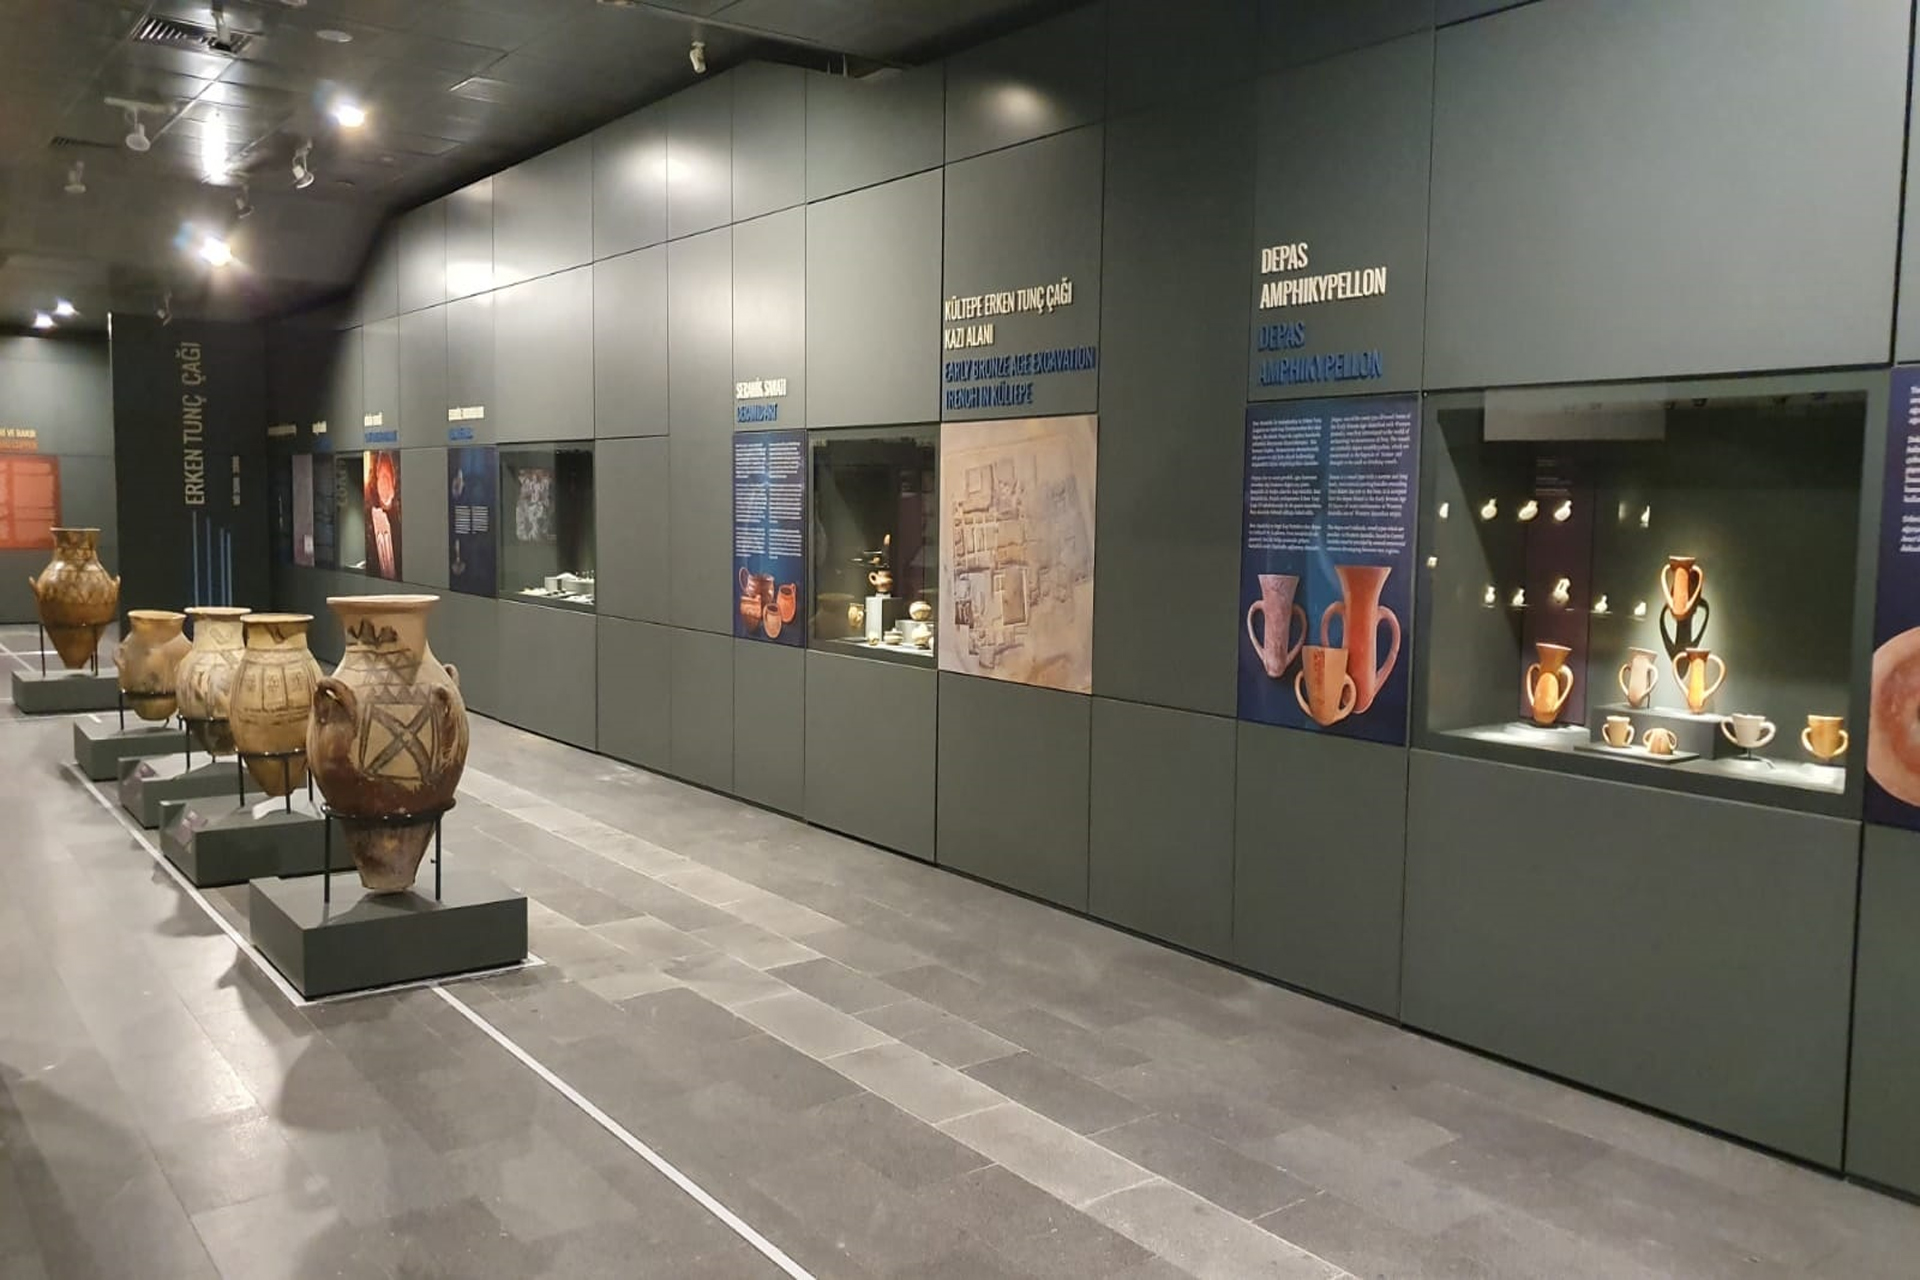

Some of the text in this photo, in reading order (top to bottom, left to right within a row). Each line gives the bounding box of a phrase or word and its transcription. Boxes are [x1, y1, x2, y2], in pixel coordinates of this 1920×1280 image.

[1261, 242, 1309, 274] DEPAS
[944, 276, 1073, 323] KÜLTEPE ERKEN TUNÇ ÇAĞI
[1259, 265, 1388, 310] AMPHIKYPELLON
[944, 323, 994, 351] KAZI ALANI
[1258, 321, 1305, 351] DEPAS
[945, 359, 972, 383] EARLY
[973, 355, 1011, 381] BRONZE
[1012, 352, 1032, 377] AGE
[1258, 347, 1384, 387] AMPHIKYPELLON
[993, 379, 1034, 407] KÜLTEPE
[175, 341, 207, 506] ERKEN TUNÇ ÇAĞI
